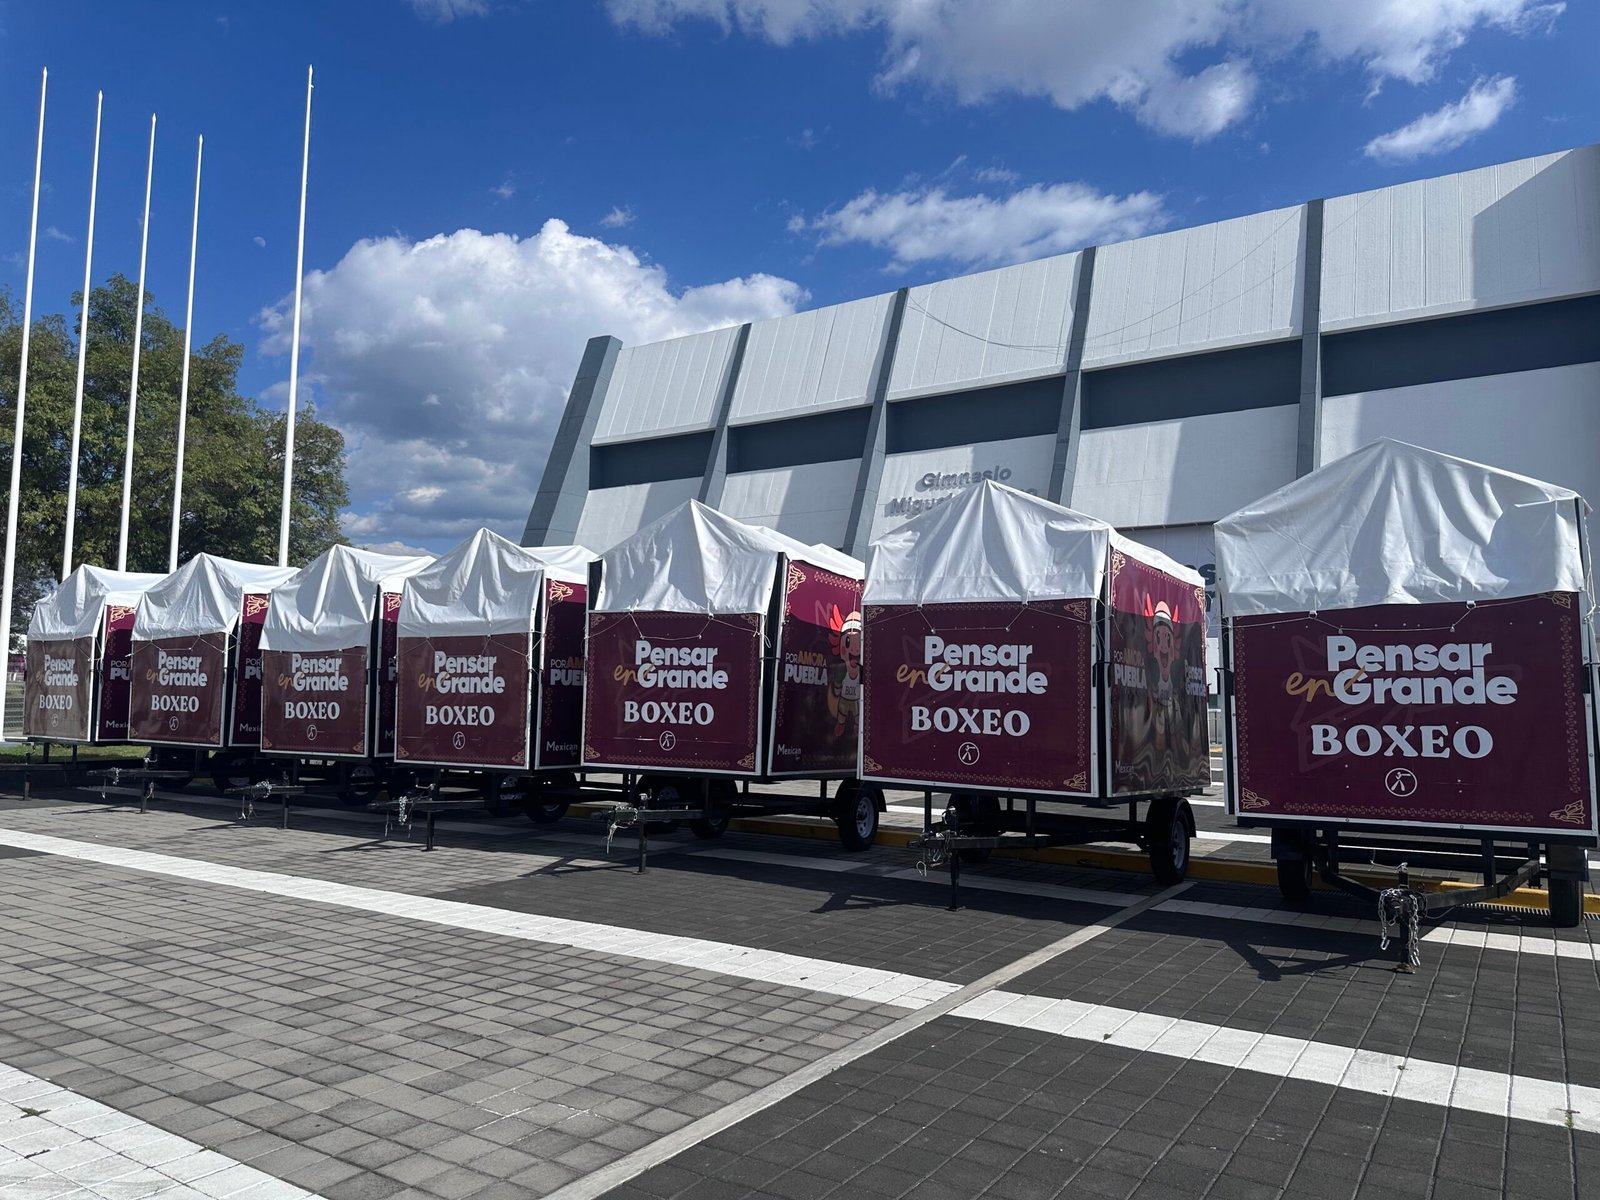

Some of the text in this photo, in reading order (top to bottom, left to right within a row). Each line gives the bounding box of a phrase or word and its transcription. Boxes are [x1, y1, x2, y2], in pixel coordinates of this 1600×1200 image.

[918, 465, 1012, 489] Gimnasio
[890, 493, 953, 516] Migu
[44, 654, 75, 671] Pensar
[158, 651, 202, 670] Pensar
[434, 651, 497, 674] Pensar
[635, 640, 718, 666] Pensar
[798, 651, 824, 666] AMOR
[924, 636, 1033, 667] Pensar
[1326, 635, 1492, 672] Pensar
[292, 653, 342, 674] Pensar
[784, 664, 828, 686] PUEBLA
[44, 670, 79, 687] Grande
[160, 668, 208, 687] Grande
[278, 673, 295, 690] en
[294, 671, 348, 692] Grande
[418, 671, 506, 694] en Grande
[613, 663, 728, 690] en Grande
[896, 662, 1048, 694] en Grande
[1114, 663, 1148, 689] PUEBLA
[1285, 666, 1518, 705] en Grande
[39, 694, 72, 710] BOXEO
[151, 694, 200, 712] BOXEO
[284, 702, 340, 720] BOXEO
[624, 701, 714, 725] BOXEO
[426, 705, 495, 726] BOXEO
[910, 706, 1030, 737] BOXEO
[546, 740, 578, 752] Mexican
[1310, 724, 1494, 759] BOXEO
